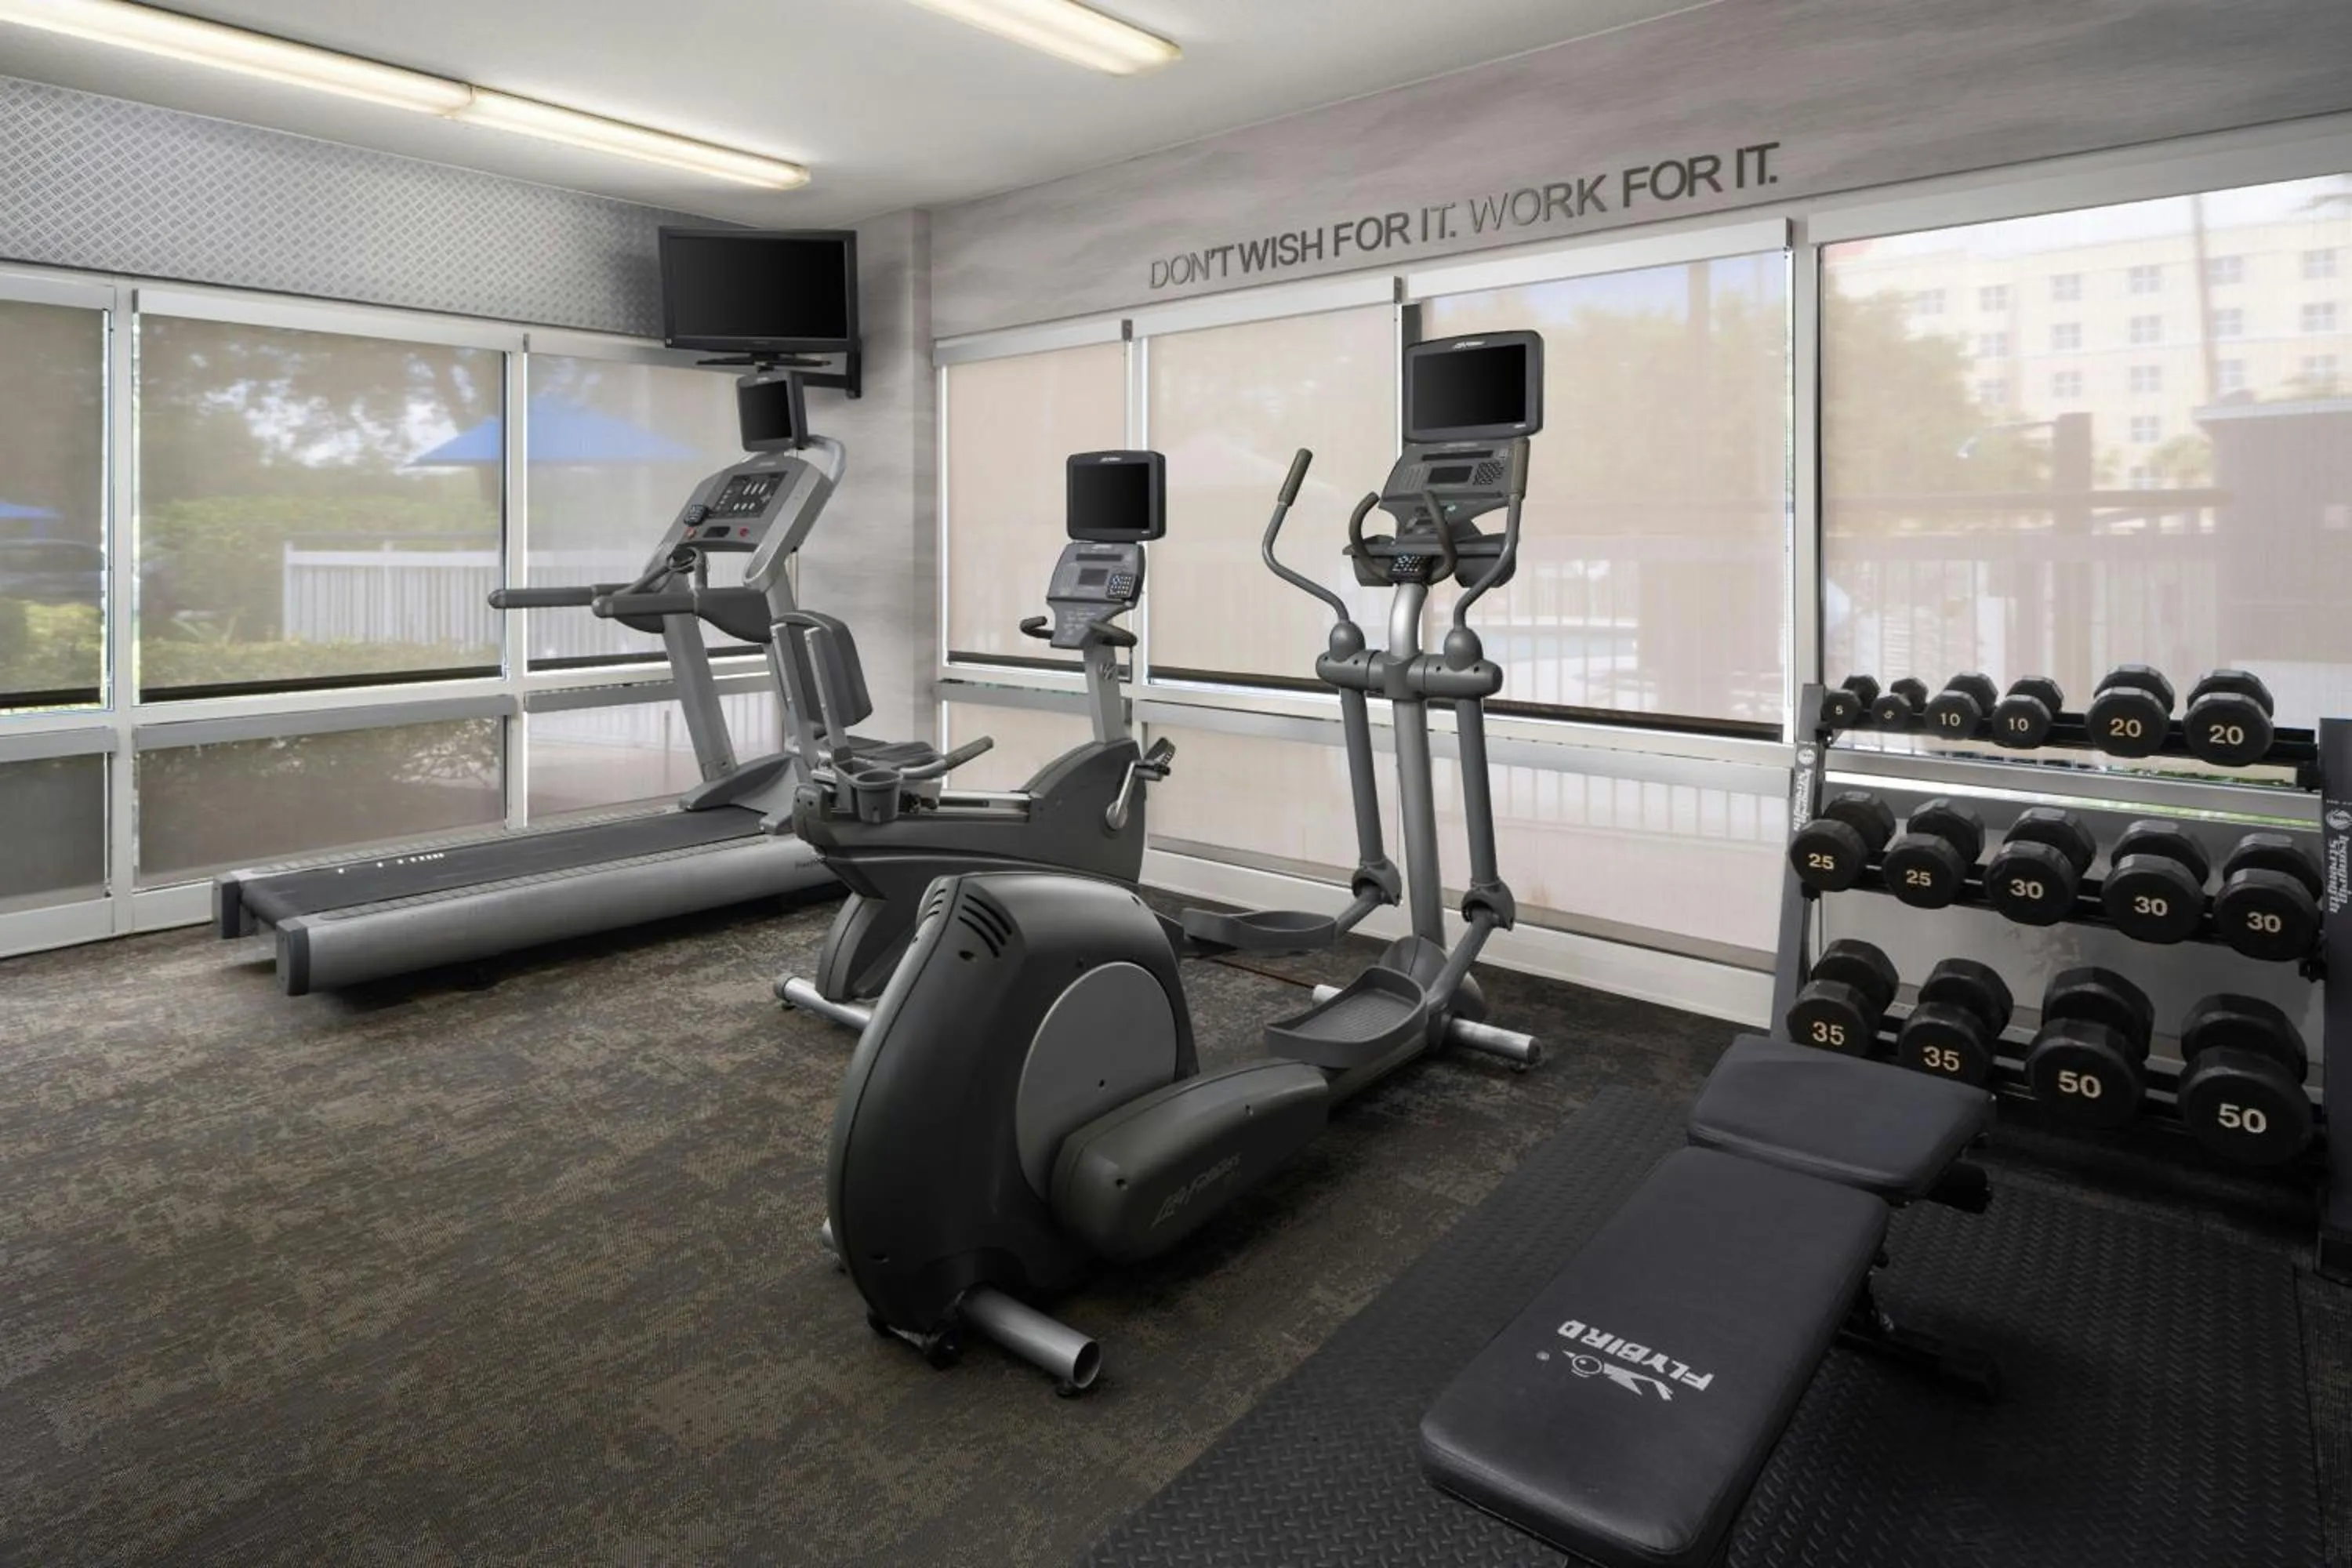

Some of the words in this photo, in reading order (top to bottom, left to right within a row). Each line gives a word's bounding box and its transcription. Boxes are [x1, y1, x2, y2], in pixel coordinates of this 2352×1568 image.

[1149, 245, 1235, 289] DON'T
[1238, 227, 1323, 274] WISH
[1334, 211, 1410, 257] FOR
[1421, 202, 1457, 242] IT.
[1469, 173, 1607, 234] WORK
[1623, 154, 1723, 208] FOR
[1736, 141, 1780, 189] IT.
[1835, 705, 1844, 715] 5
[1940, 713, 1961, 727] 10
[2009, 717, 2029, 731] 10
[2110, 717, 2142, 738] 20
[2209, 724, 2245, 746] 20
[1809, 852, 1835, 870] 25
[1906, 869, 1932, 887] 25
[2010, 879, 2044, 899] 30
[2134, 895, 2168, 916] 30
[2247, 911, 2281, 933] 30
[1812, 1022, 1845, 1047] 35
[1922, 1045, 1960, 1073] 35
[2059, 1070, 2101, 1098] 50
[2218, 1103, 2267, 1134] 50
[1557, 1319, 1715, 1391] FLYBIRD
